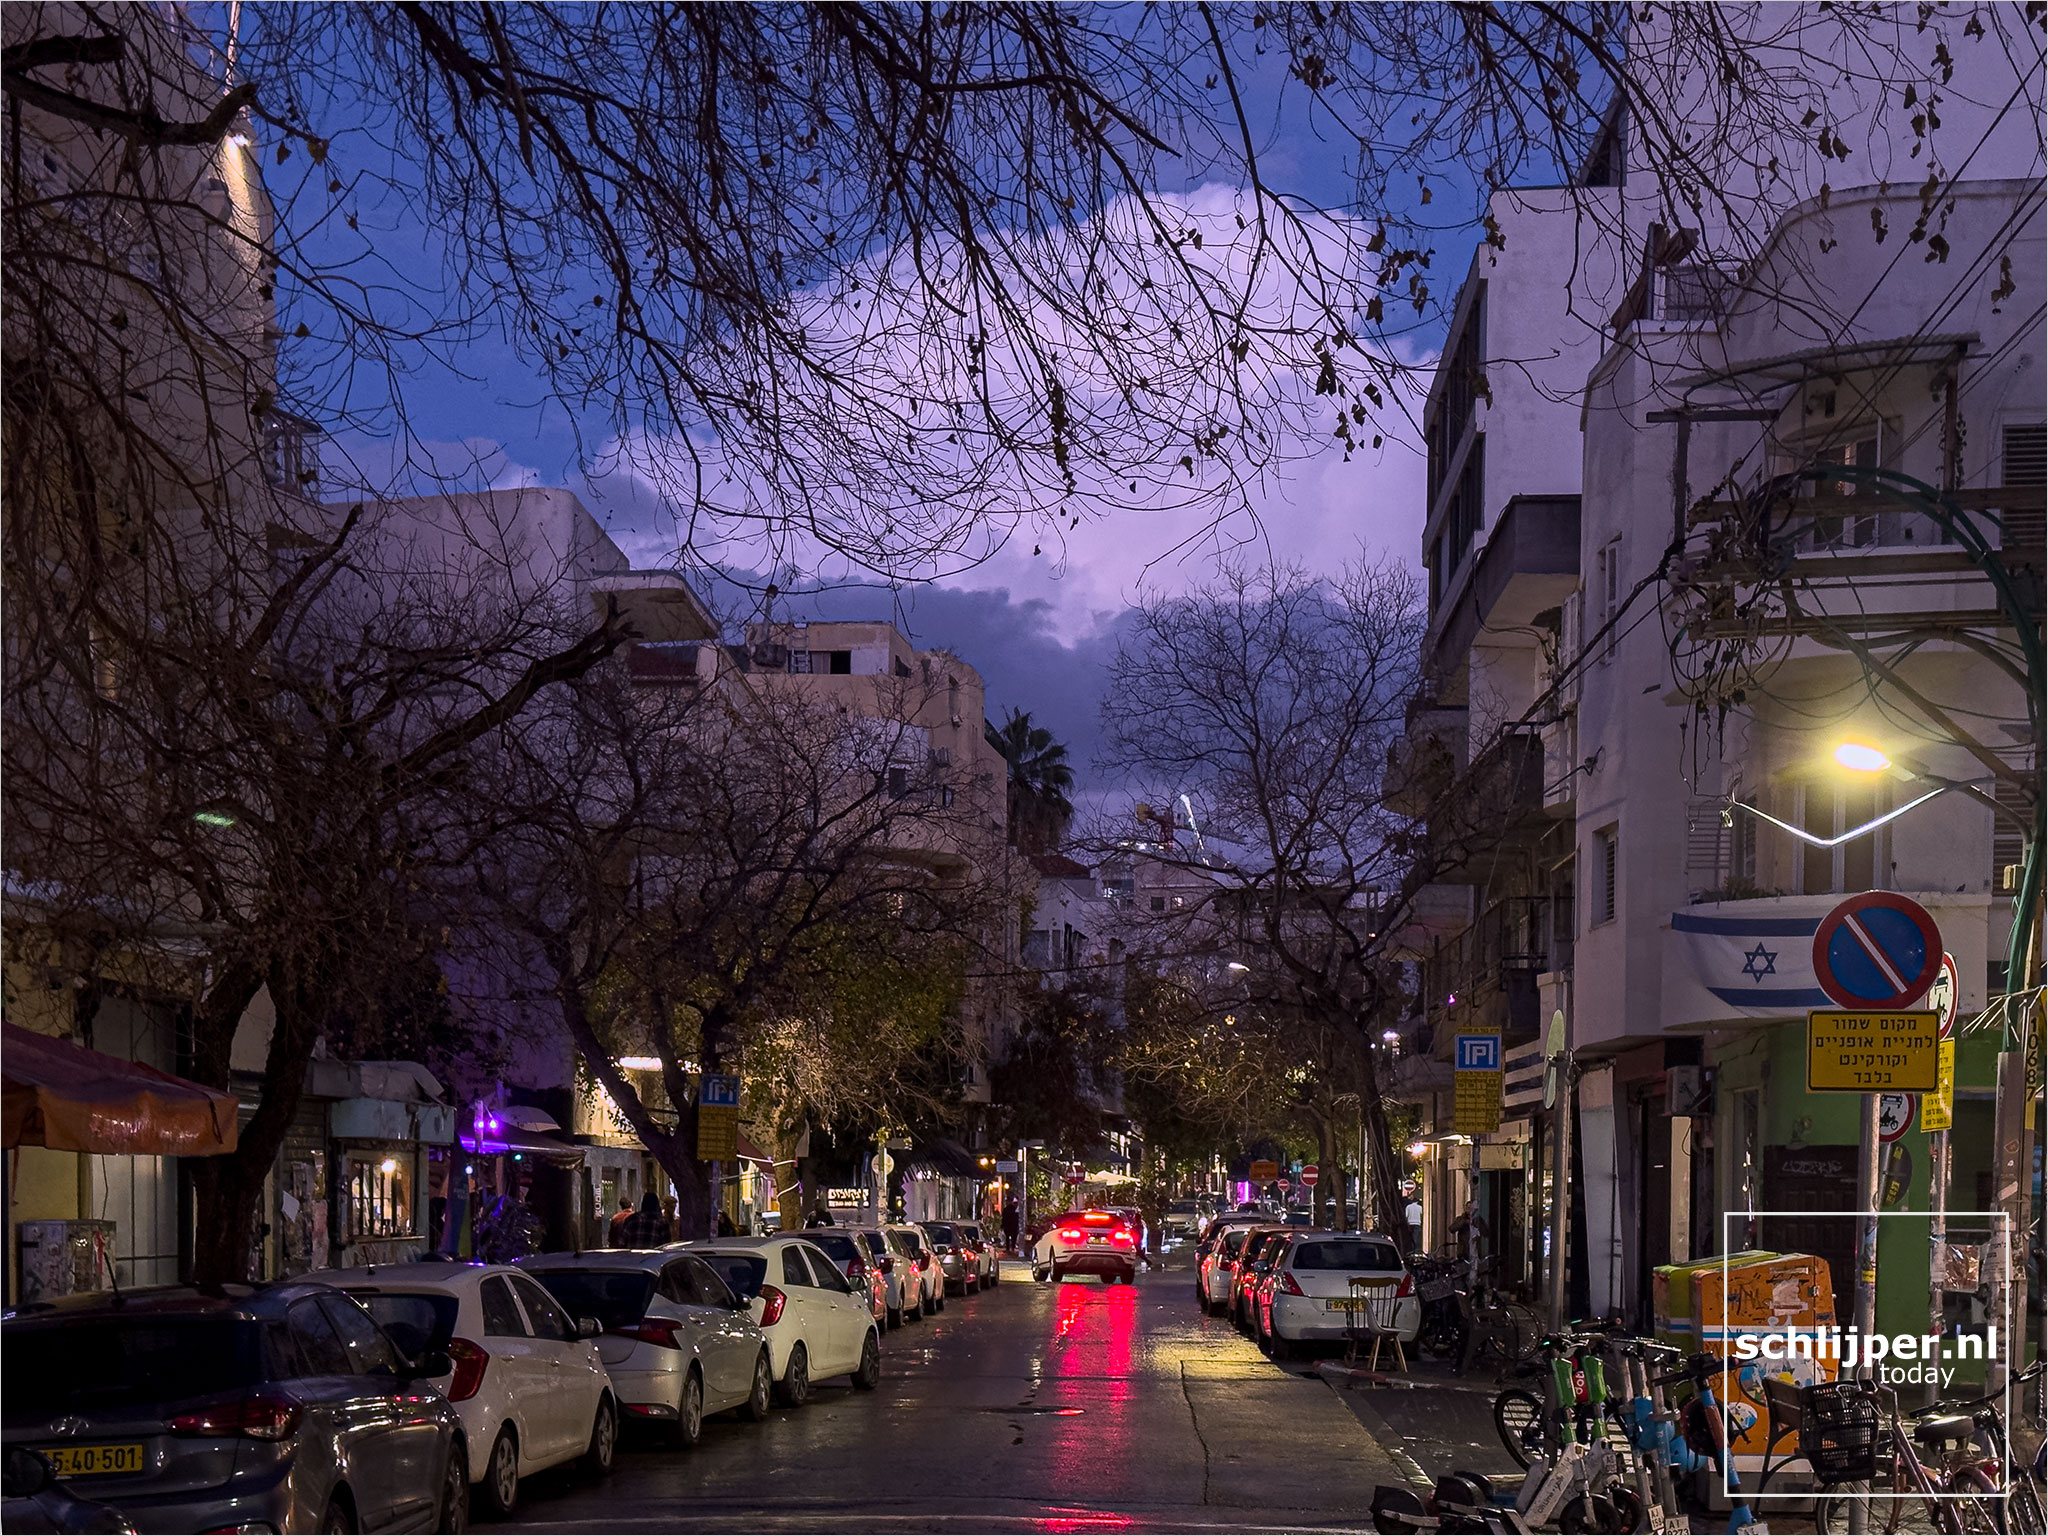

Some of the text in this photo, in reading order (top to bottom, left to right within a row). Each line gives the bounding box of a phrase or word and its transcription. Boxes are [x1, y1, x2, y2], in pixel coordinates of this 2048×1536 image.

[1831, 1018, 1917, 1031] מקום שמור
[1815, 1035, 1933, 1048] לחניית אופניים
[1839, 1054, 1908, 1068] וקורקינט
[1853, 1070, 1892, 1084] בלבד
